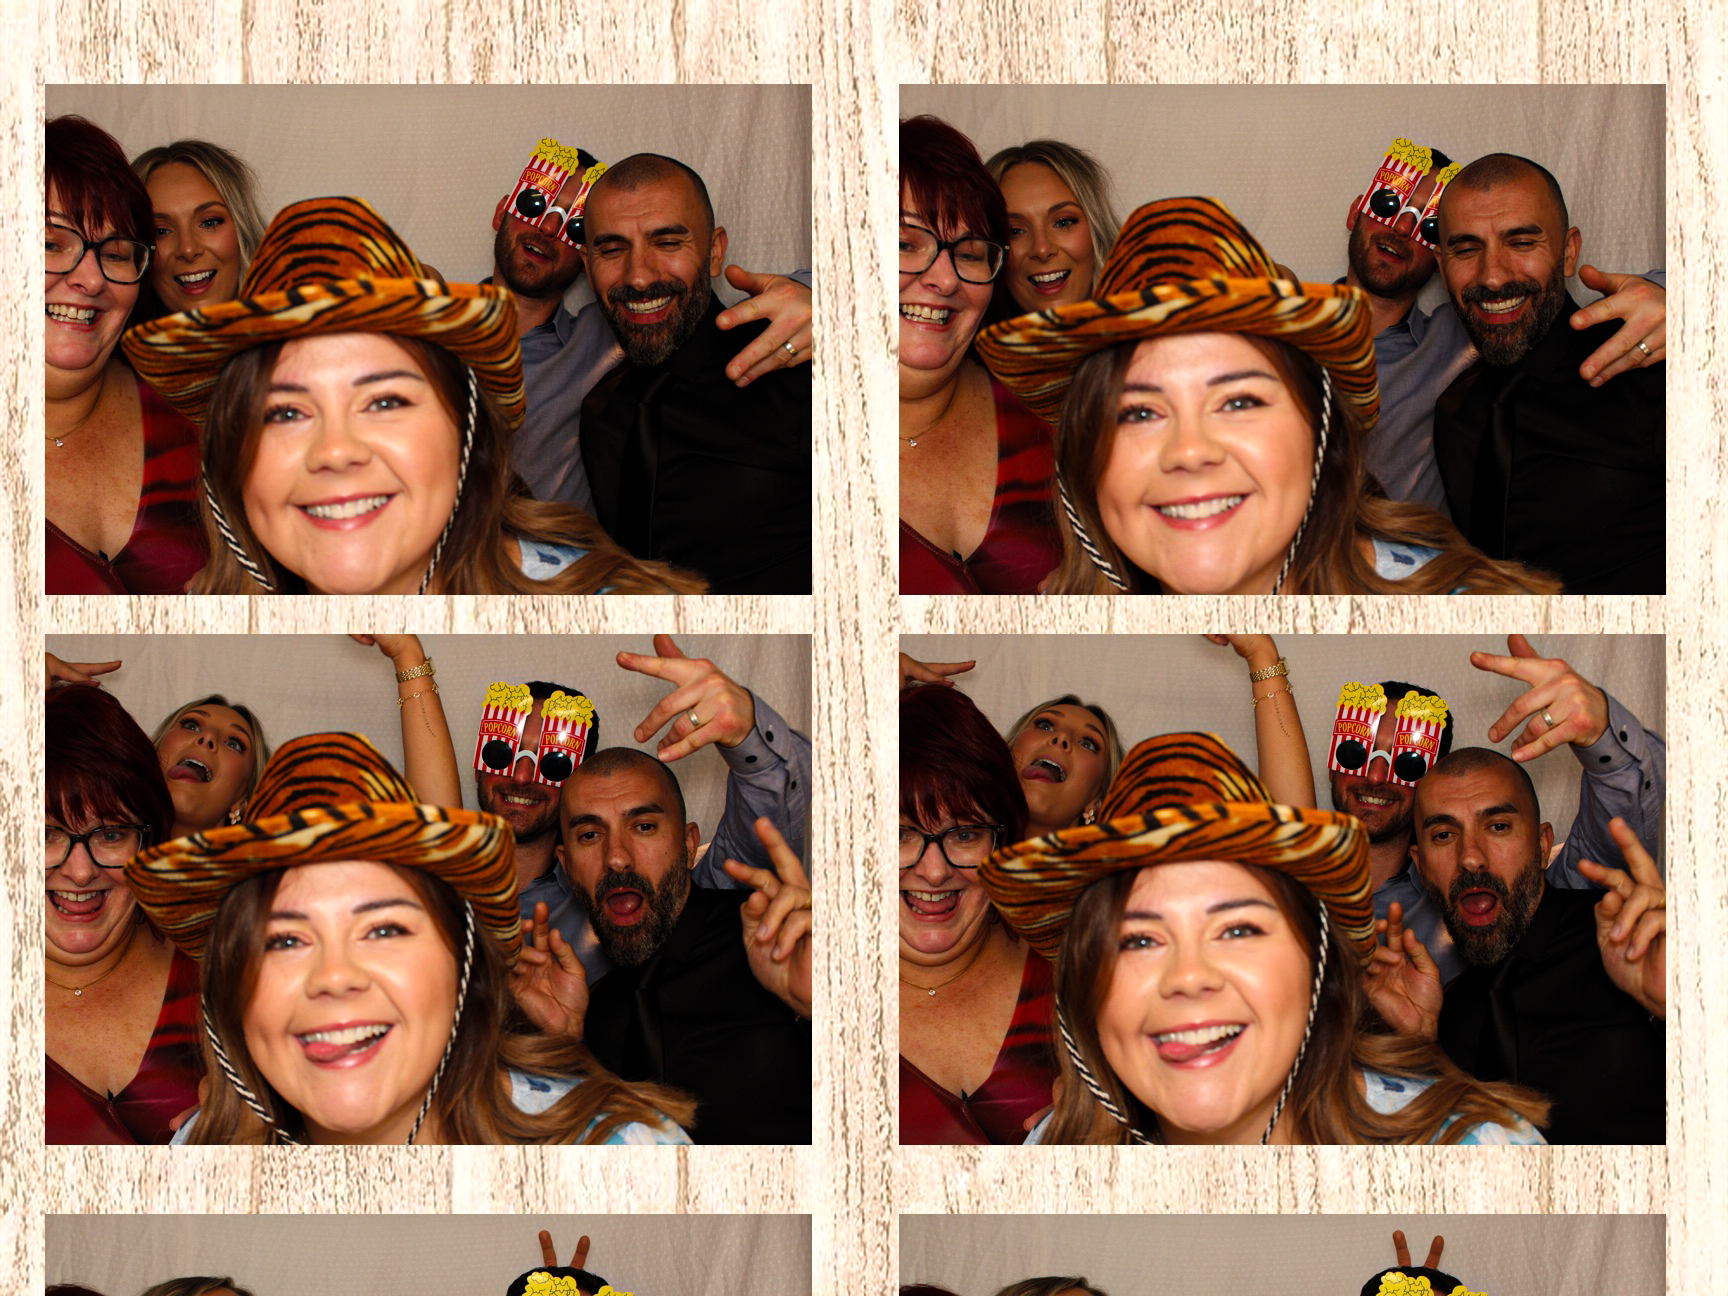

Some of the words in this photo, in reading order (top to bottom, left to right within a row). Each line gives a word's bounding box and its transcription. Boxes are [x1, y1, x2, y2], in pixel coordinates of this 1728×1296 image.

[525, 170, 558, 193] POPCORN
[1379, 170, 1412, 193] POPCORN
[483, 721, 517, 739] POPCORN
[1337, 721, 1371, 739] POPCORN
